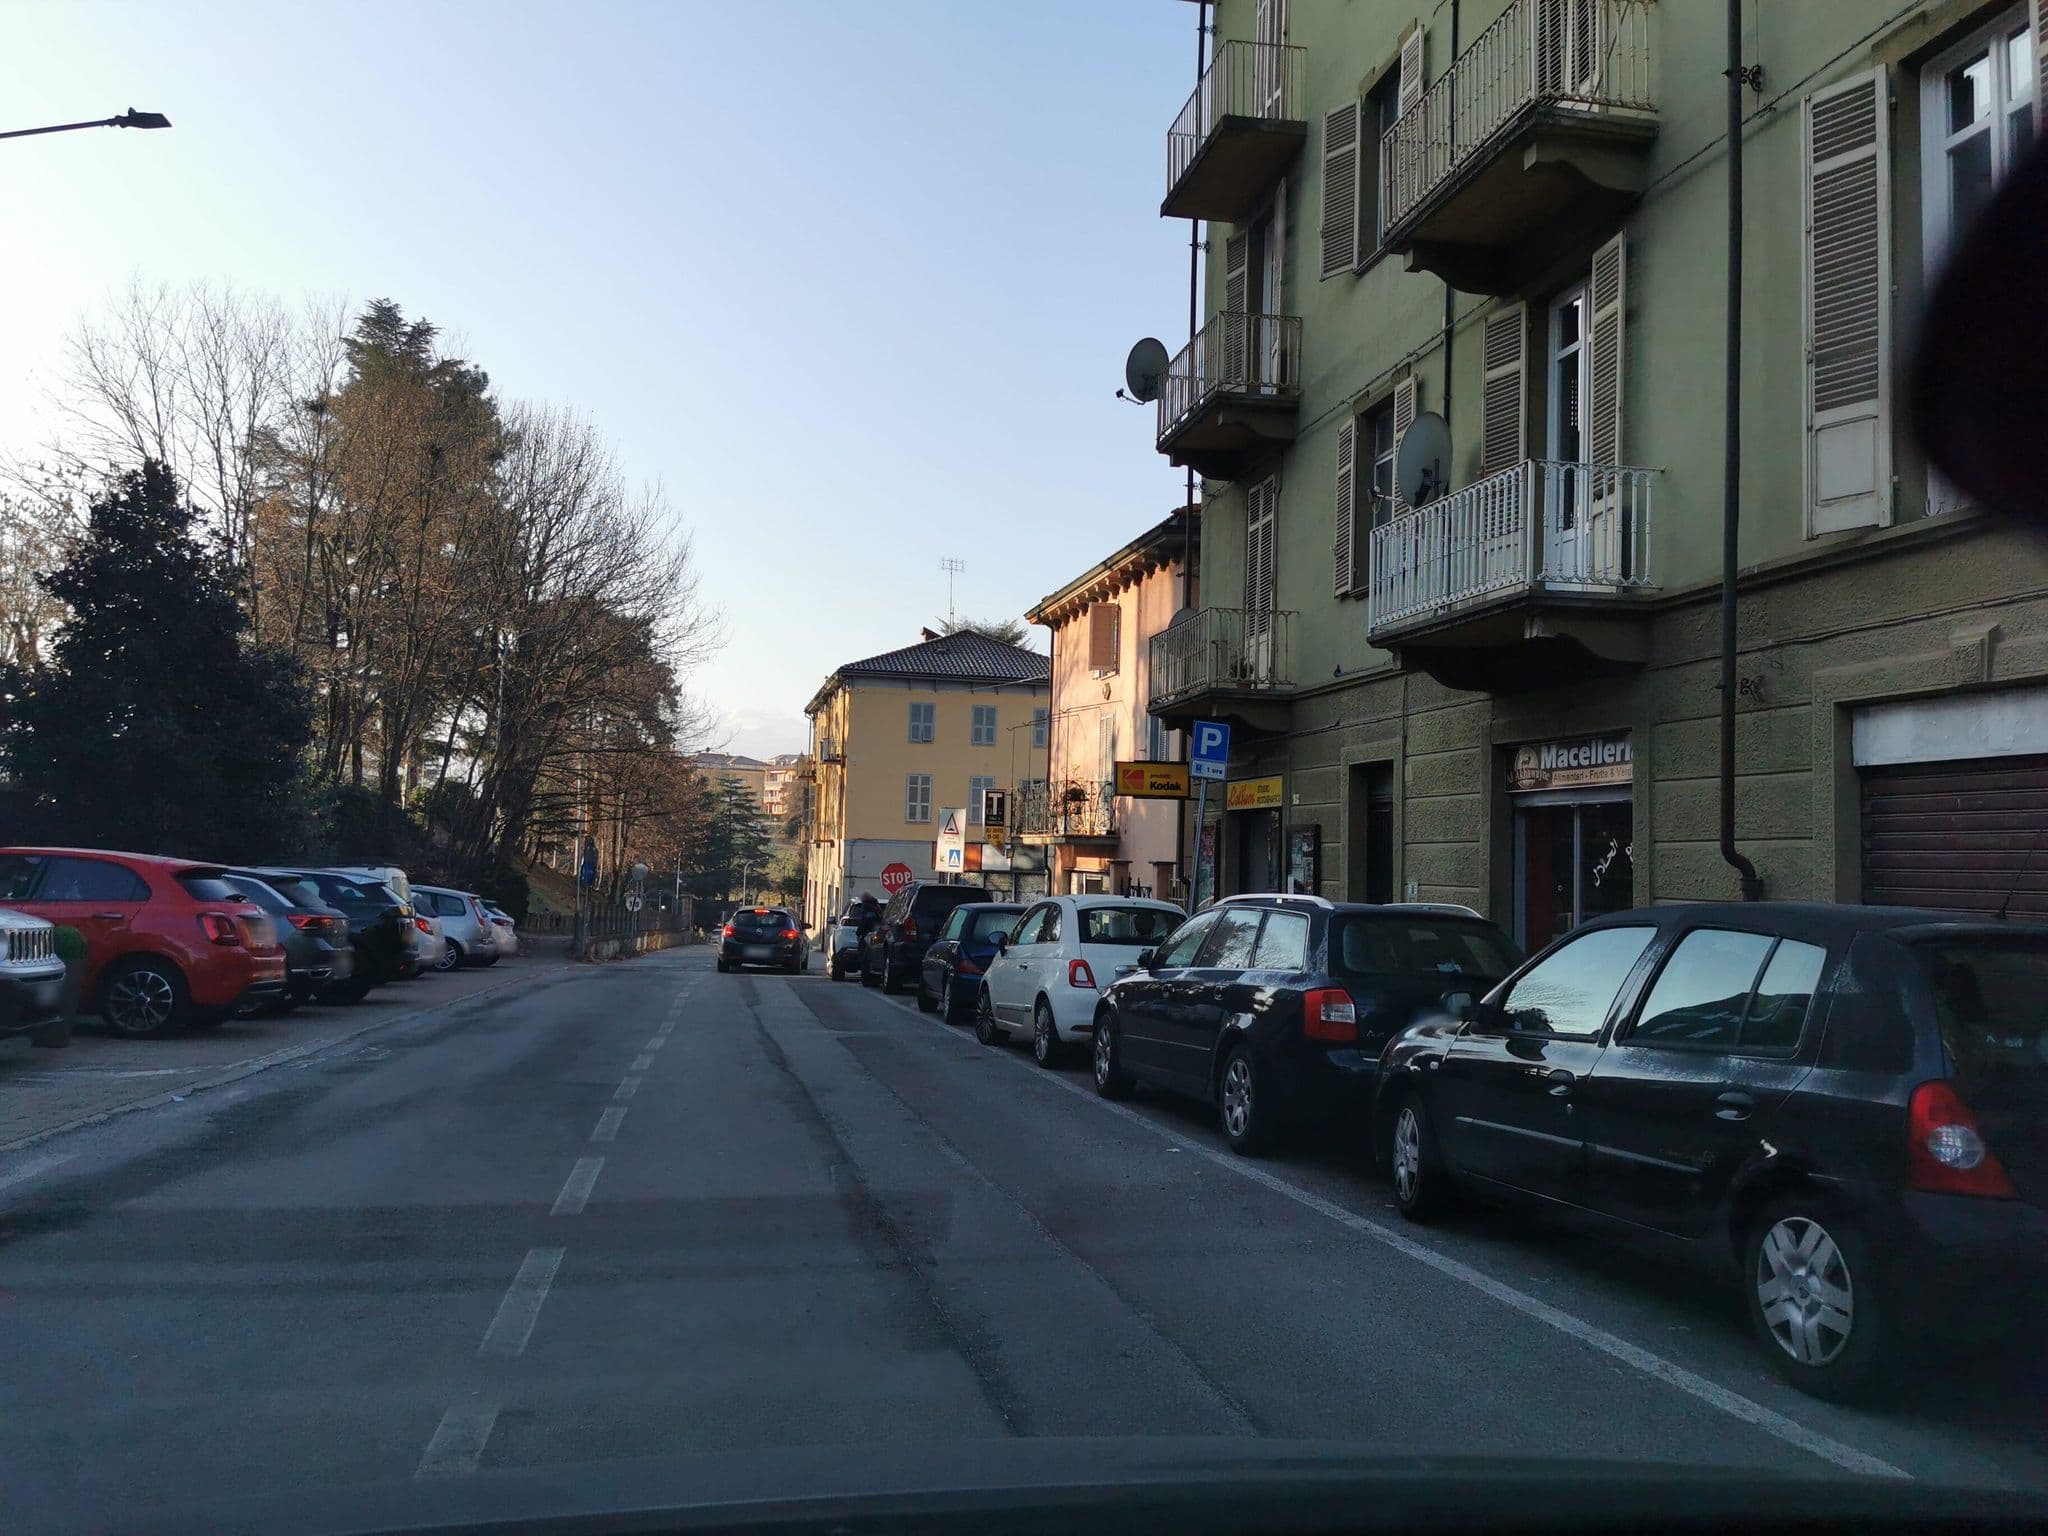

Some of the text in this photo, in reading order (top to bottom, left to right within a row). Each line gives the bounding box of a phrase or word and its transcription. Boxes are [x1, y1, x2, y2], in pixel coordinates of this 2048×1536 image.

[1200, 727, 1222, 755] P
[1541, 741, 1633, 769] Macelleri
[1150, 781, 1182, 791] Kodak
[988, 793, 1003, 815] T
[882, 871, 911, 885] STOP
